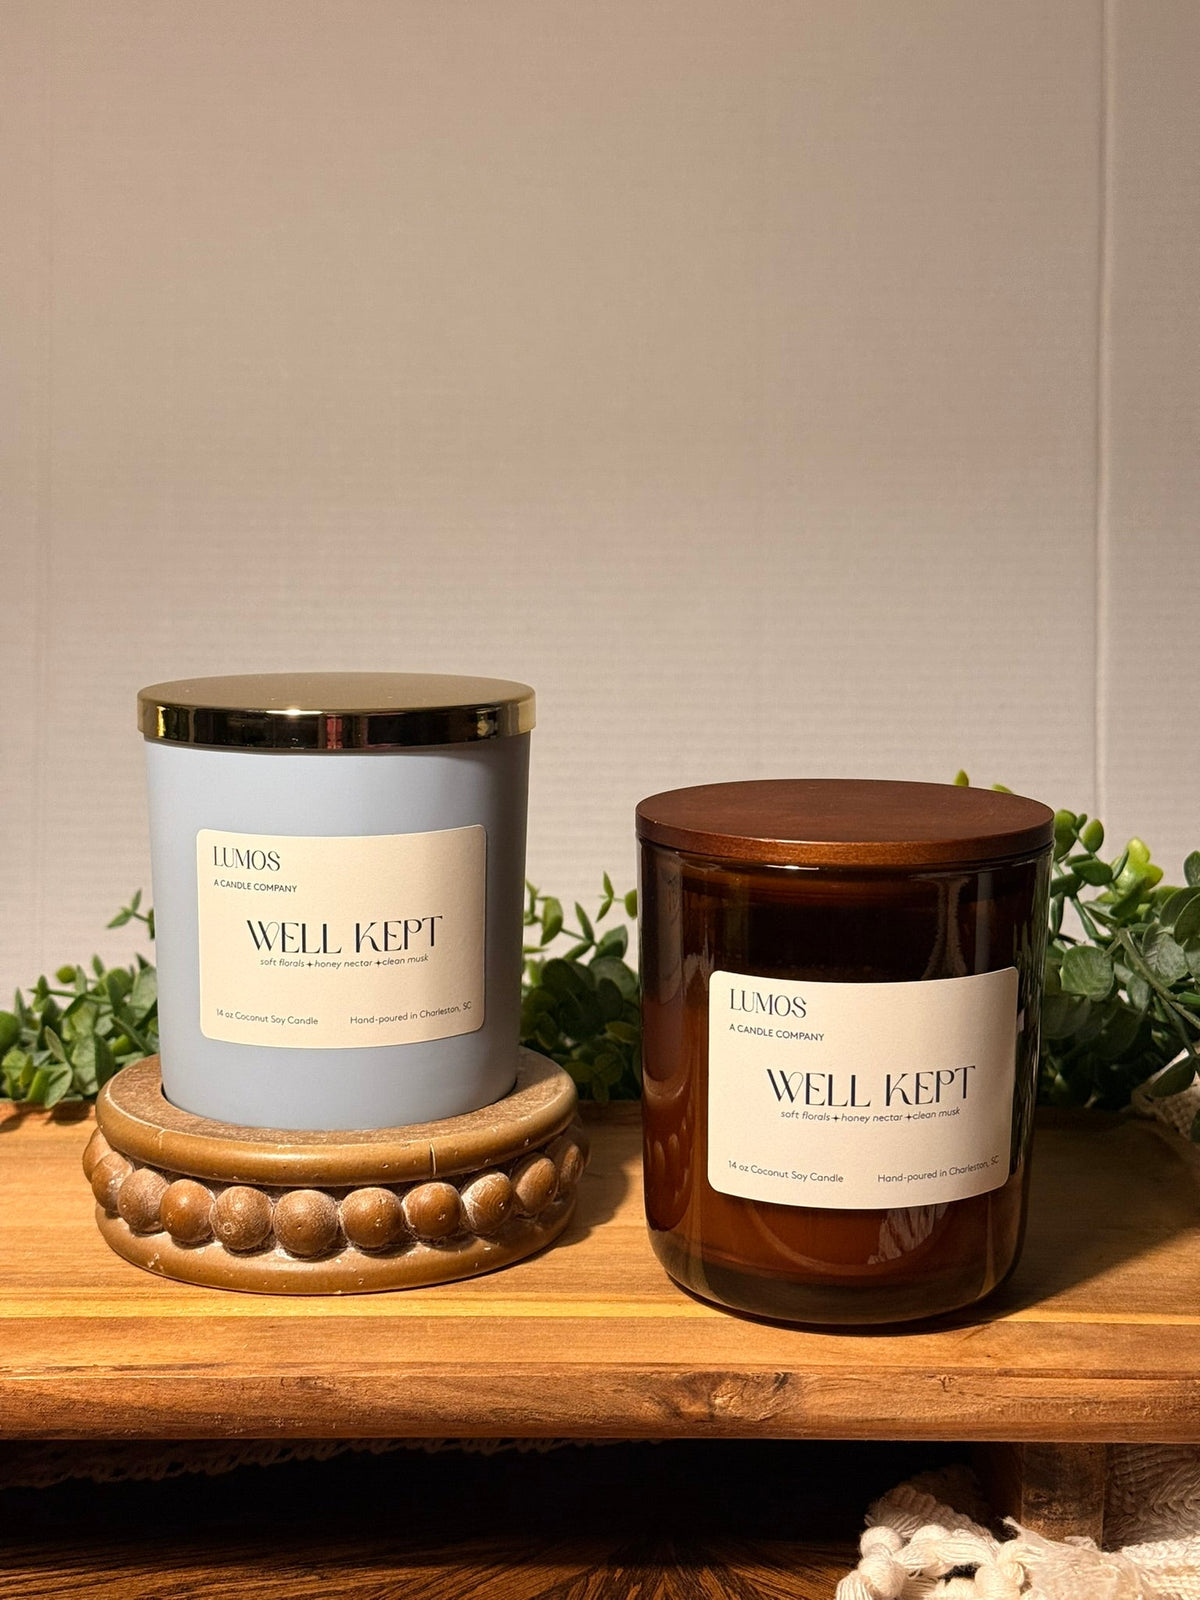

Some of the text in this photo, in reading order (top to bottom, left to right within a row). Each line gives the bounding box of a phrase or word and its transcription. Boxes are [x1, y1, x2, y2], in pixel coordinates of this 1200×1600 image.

[213, 845, 281, 872] LUMOS
[213, 879, 298, 893] A CANDLE COMPANY
[246, 915, 443, 954] WELL KEPT
[260, 958, 277, 966] soft
[407, 953, 429, 963] musk
[350, 1001, 472, 1025] Hand-poured in Charleston, SC
[729, 988, 808, 1019] LUMOS
[216, 1008, 224, 1017] 14
[234, 1011, 269, 1023] Coconut
[270, 1016, 286, 1026] Soy
[287, 1016, 319, 1025] Candle
[729, 1023, 825, 1042] A CANDLE COMPANY
[766, 1065, 976, 1108] WELL KEPT
[780, 1109, 800, 1119] soft
[938, 1106, 961, 1117] musk
[727, 1160, 845, 1183] 14 oz Coconut Soy Candle
[877, 1154, 1000, 1183] Hand-poured in Charleston, SC
